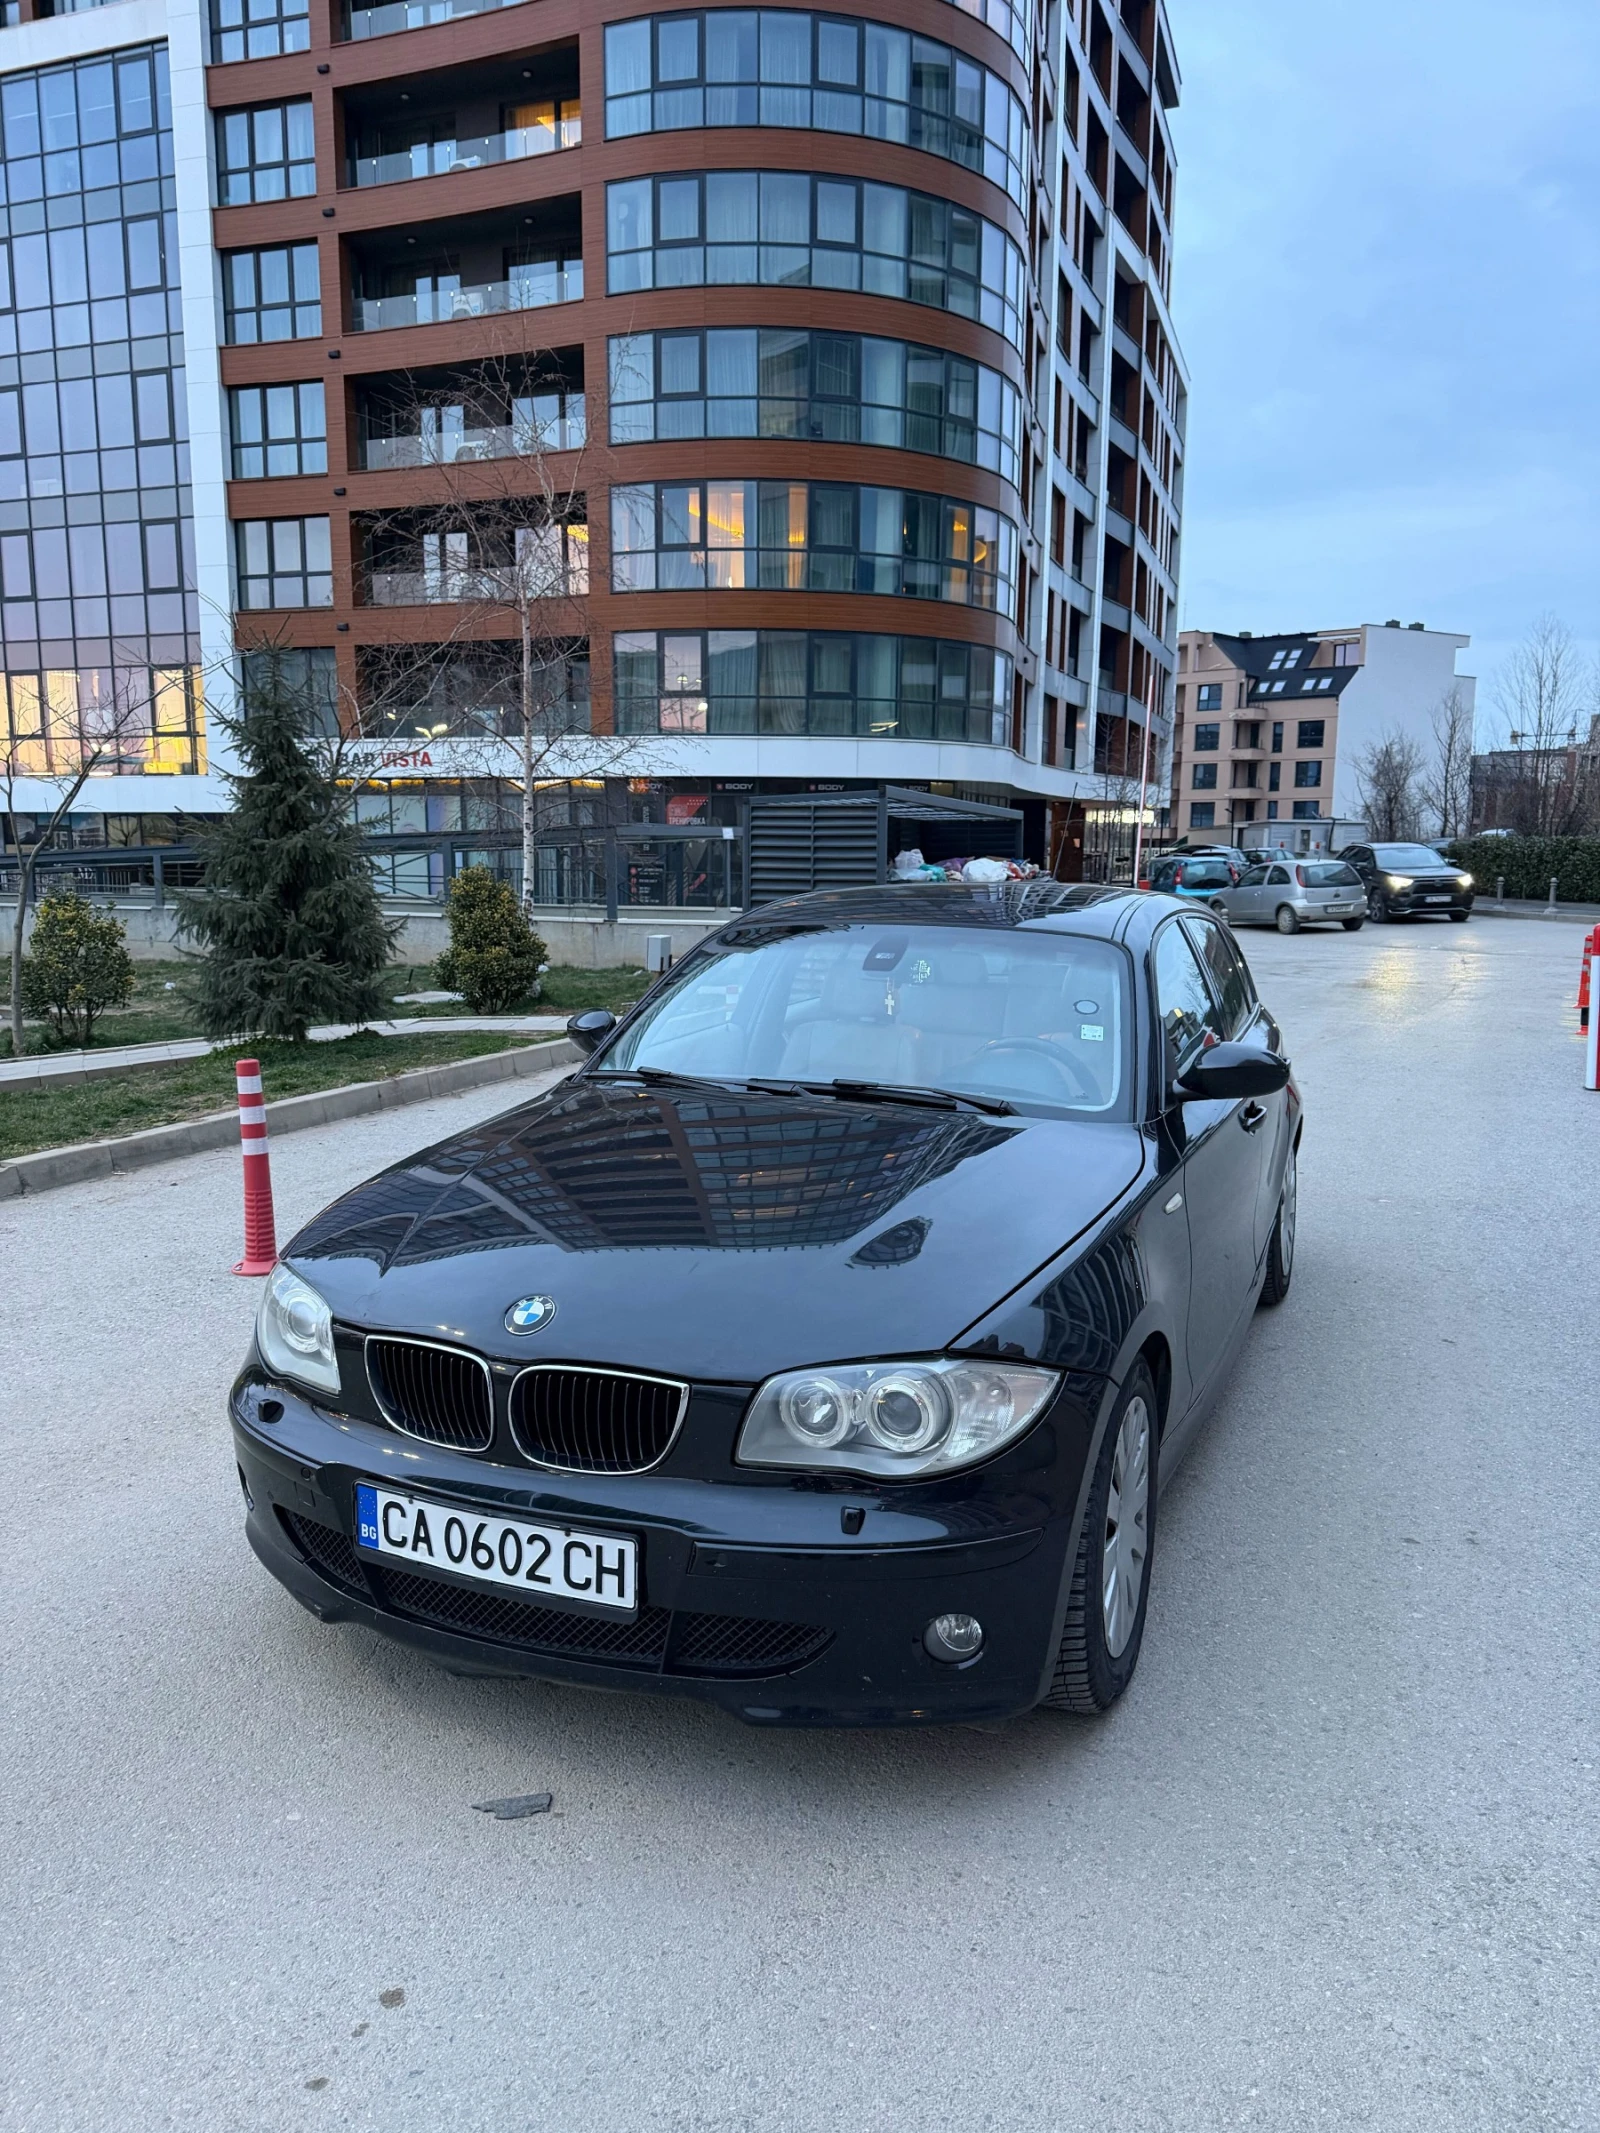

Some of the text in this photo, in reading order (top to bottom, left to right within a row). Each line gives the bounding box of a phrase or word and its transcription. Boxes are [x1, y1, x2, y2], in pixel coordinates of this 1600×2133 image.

[340, 752, 375, 767] BAR
[381, 751, 433, 768] VISTA
[360, 1522, 378, 1541] BG
[382, 1501, 626, 1599] CA 0602 CH
